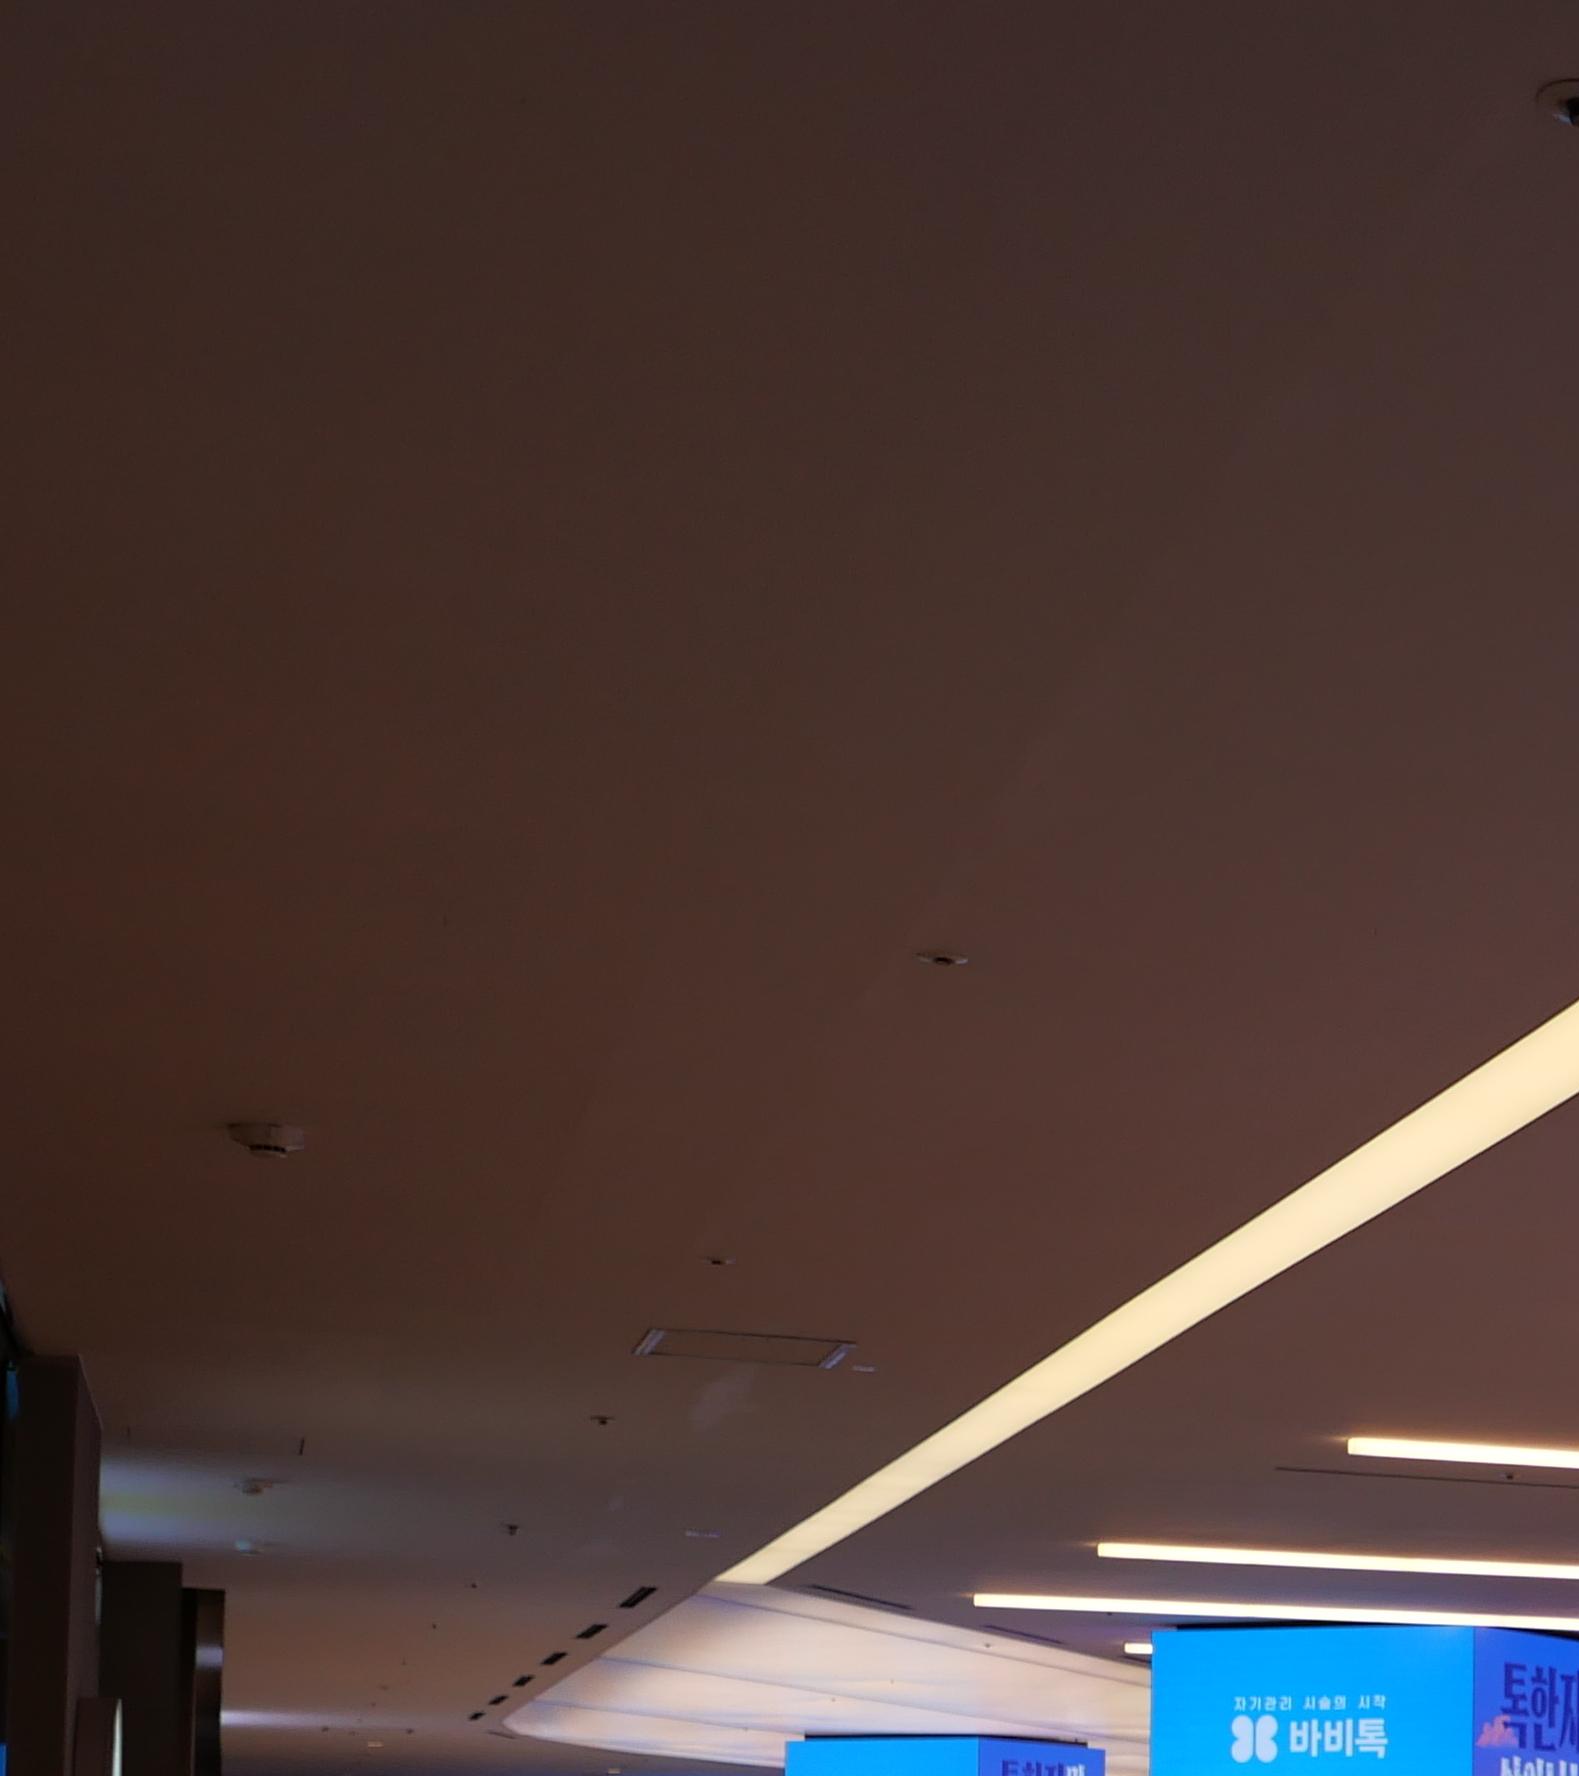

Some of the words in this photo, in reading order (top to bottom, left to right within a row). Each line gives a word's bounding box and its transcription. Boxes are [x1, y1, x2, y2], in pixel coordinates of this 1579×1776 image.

[1234, 1695, 1292, 1711] 자기관리
[1303, 1694, 1347, 1711] 시술의
[1358, 1694, 1386, 1710] 시작
[1289, 1717, 1388, 1759] 바비톡
